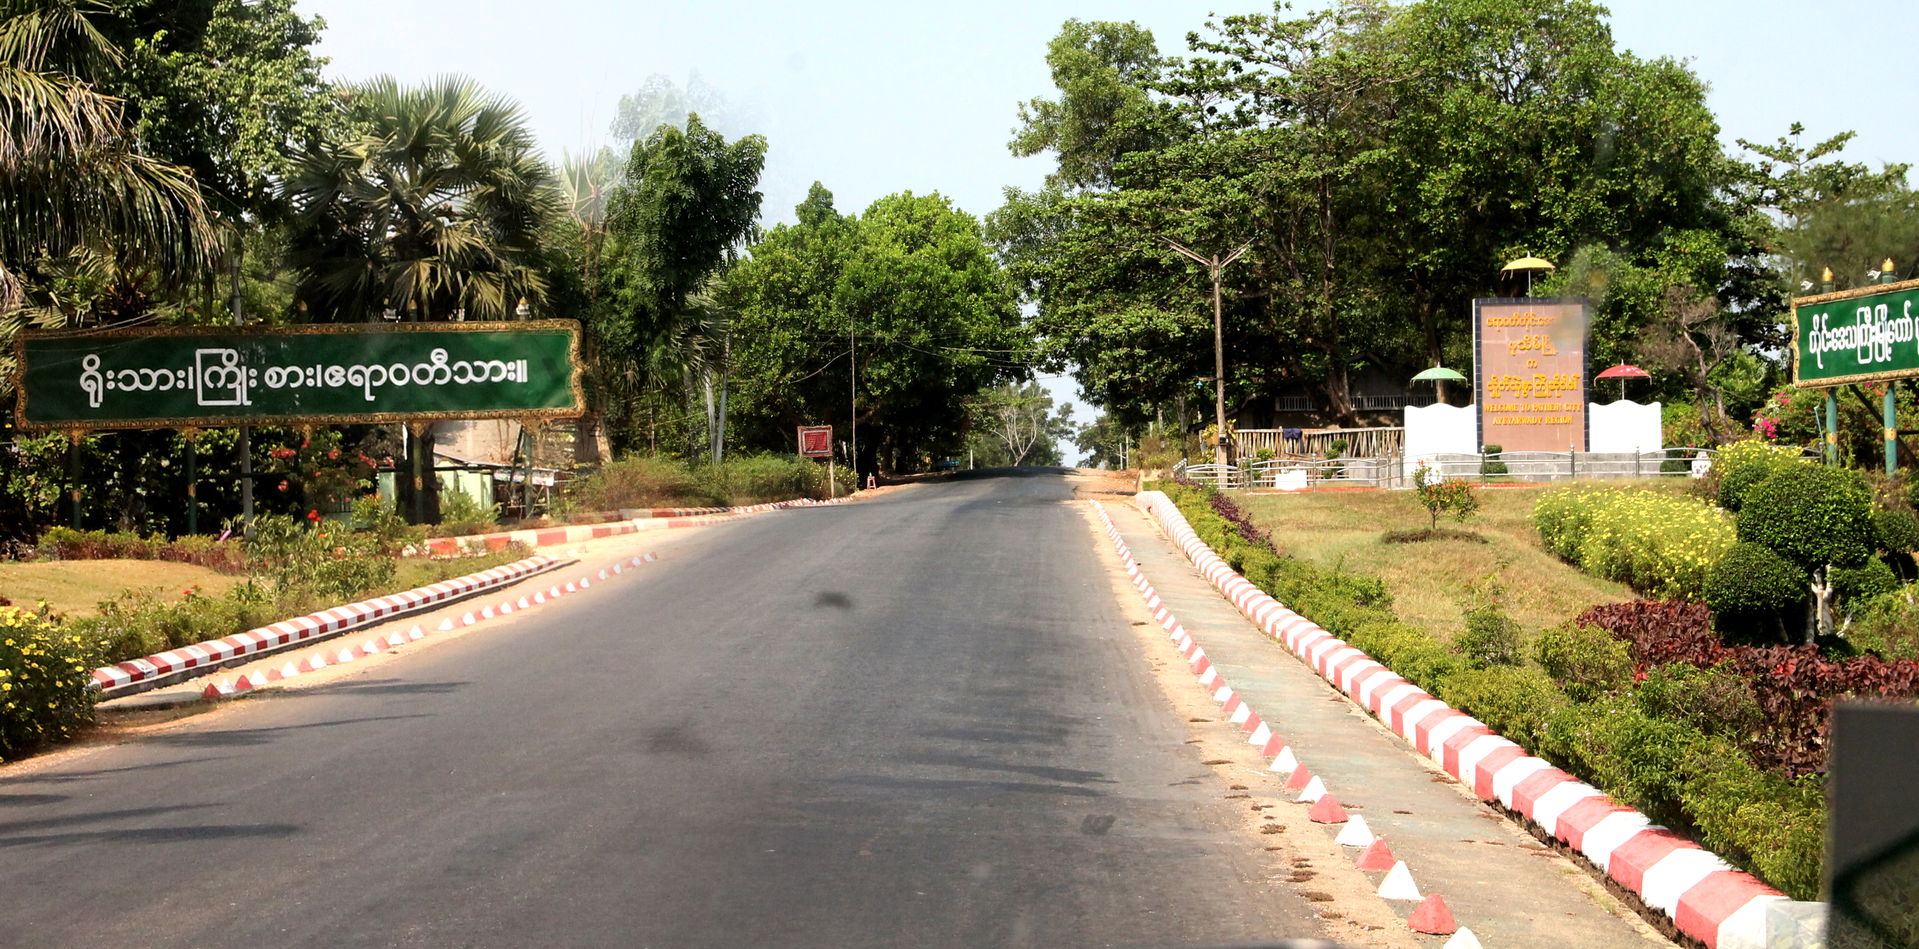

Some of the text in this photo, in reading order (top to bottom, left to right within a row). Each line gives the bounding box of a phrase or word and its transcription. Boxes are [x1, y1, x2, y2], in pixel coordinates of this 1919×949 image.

[1527, 359, 1538, 368] က
[1484, 402, 1581, 412] WELCOME TO PATHEIN CITY
[1493, 414, 1574, 425] AYEYARWADY REGION
